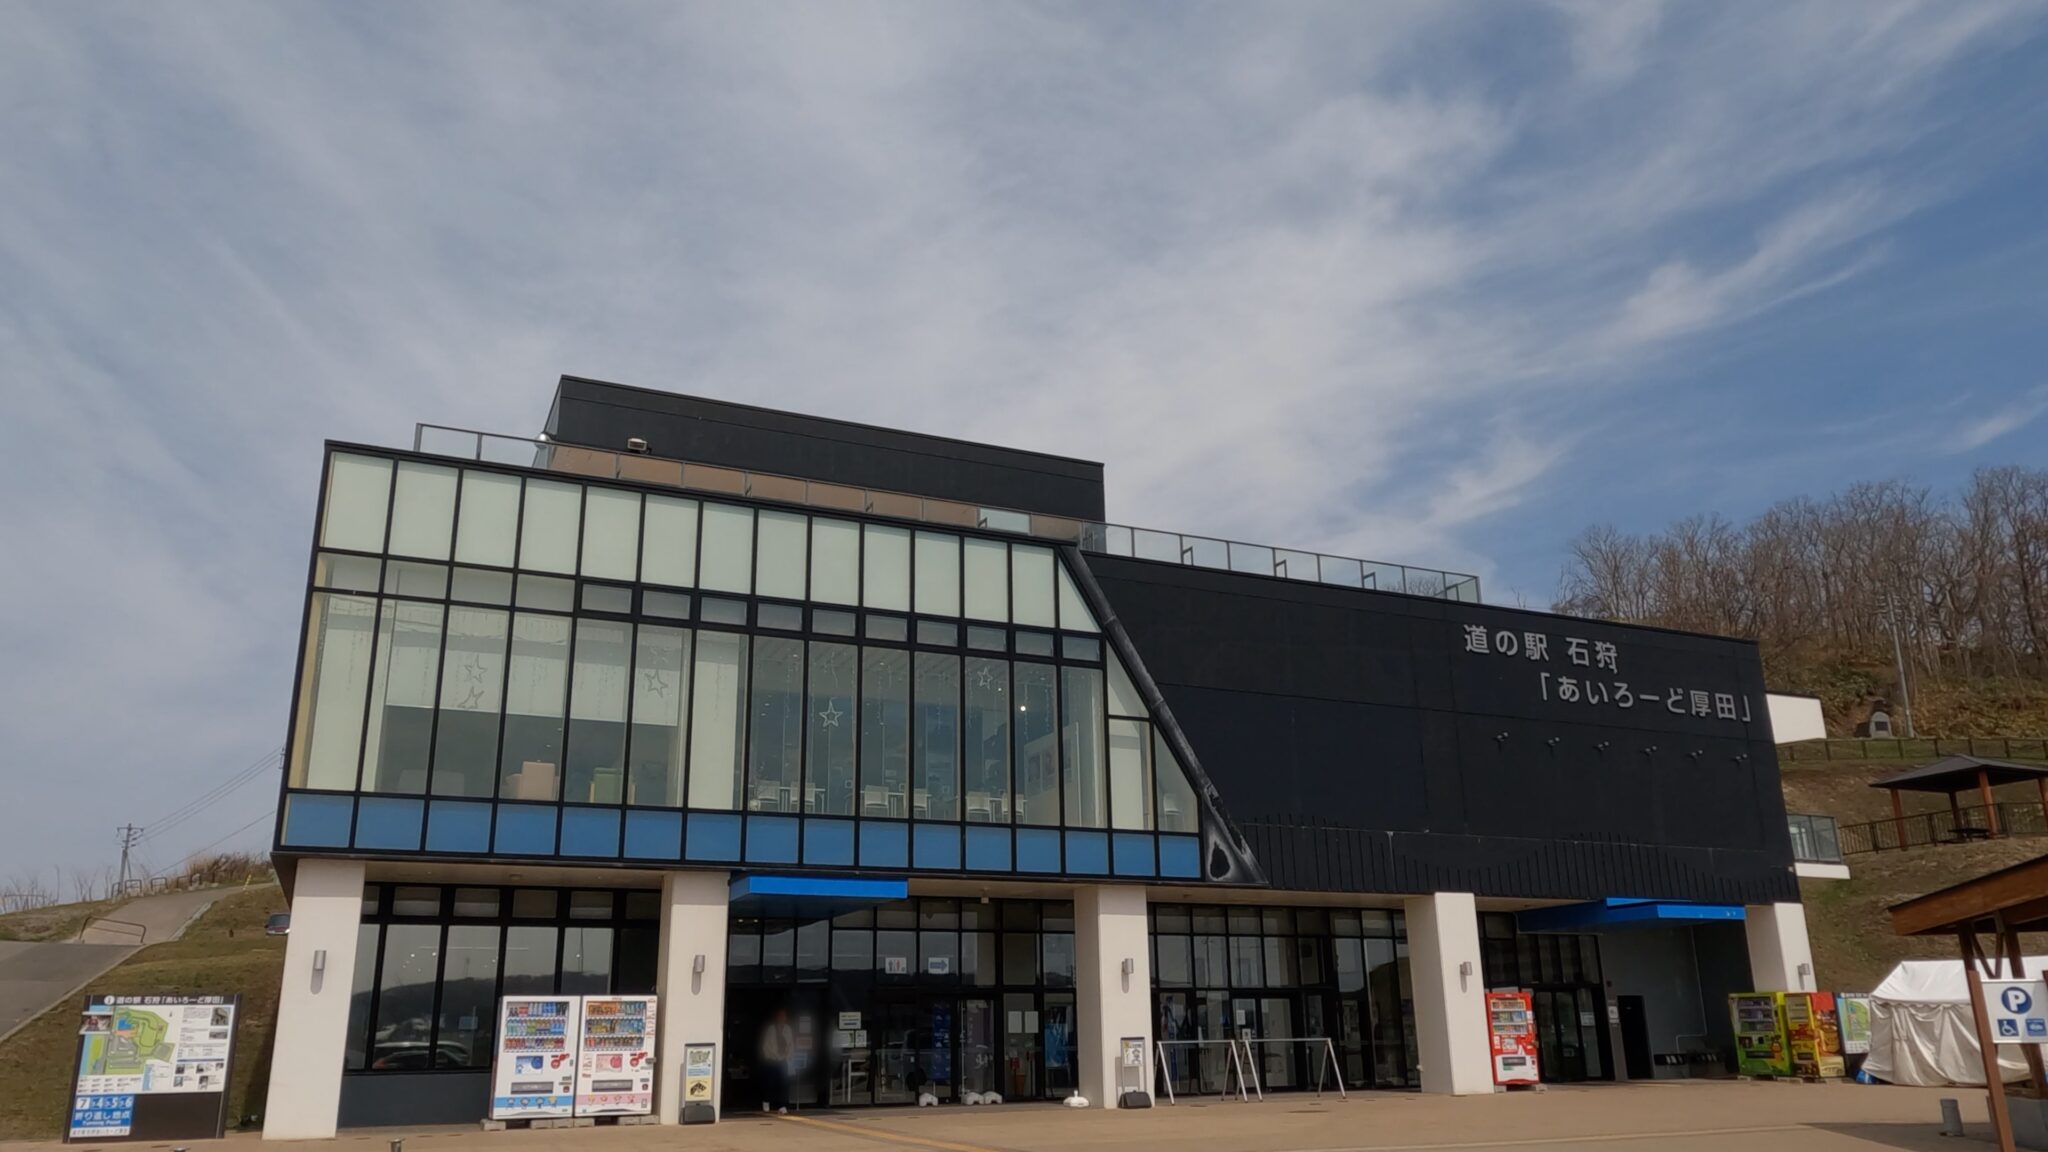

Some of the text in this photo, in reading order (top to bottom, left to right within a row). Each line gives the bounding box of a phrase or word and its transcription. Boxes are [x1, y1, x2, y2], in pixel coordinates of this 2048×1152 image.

[1464, 624, 1618, 674] 道の駅 石狩
[1540, 672, 1752, 723] 「あいろーど厚田」
[116, 996, 141, 1005] 道の駅
[2007, 990, 2027, 1011] P
